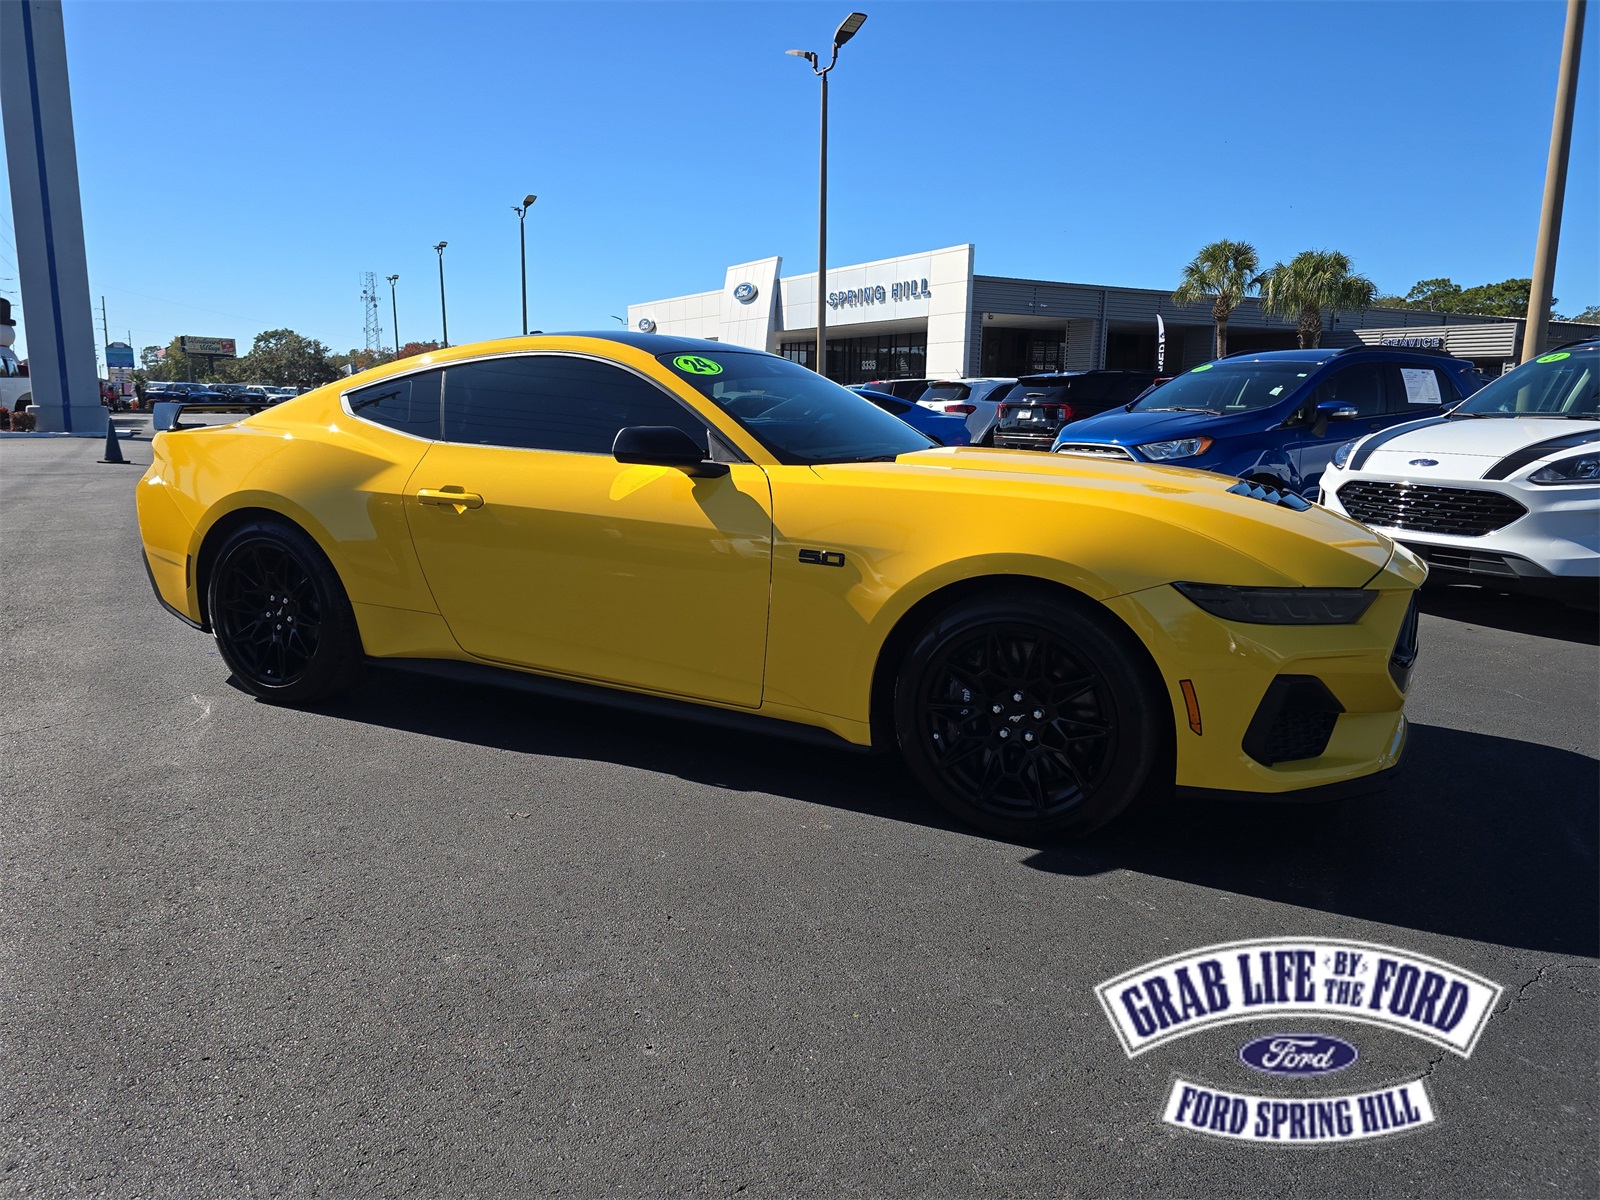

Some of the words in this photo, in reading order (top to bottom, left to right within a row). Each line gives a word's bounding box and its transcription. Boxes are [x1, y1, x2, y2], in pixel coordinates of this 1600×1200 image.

[827, 285, 884, 308] SPRING
[891, 278, 930, 300] HILL
[1382, 337, 1440, 348] SERVICE
[682, 357, 717, 373] 24
[861, 360, 877, 370] 3335
